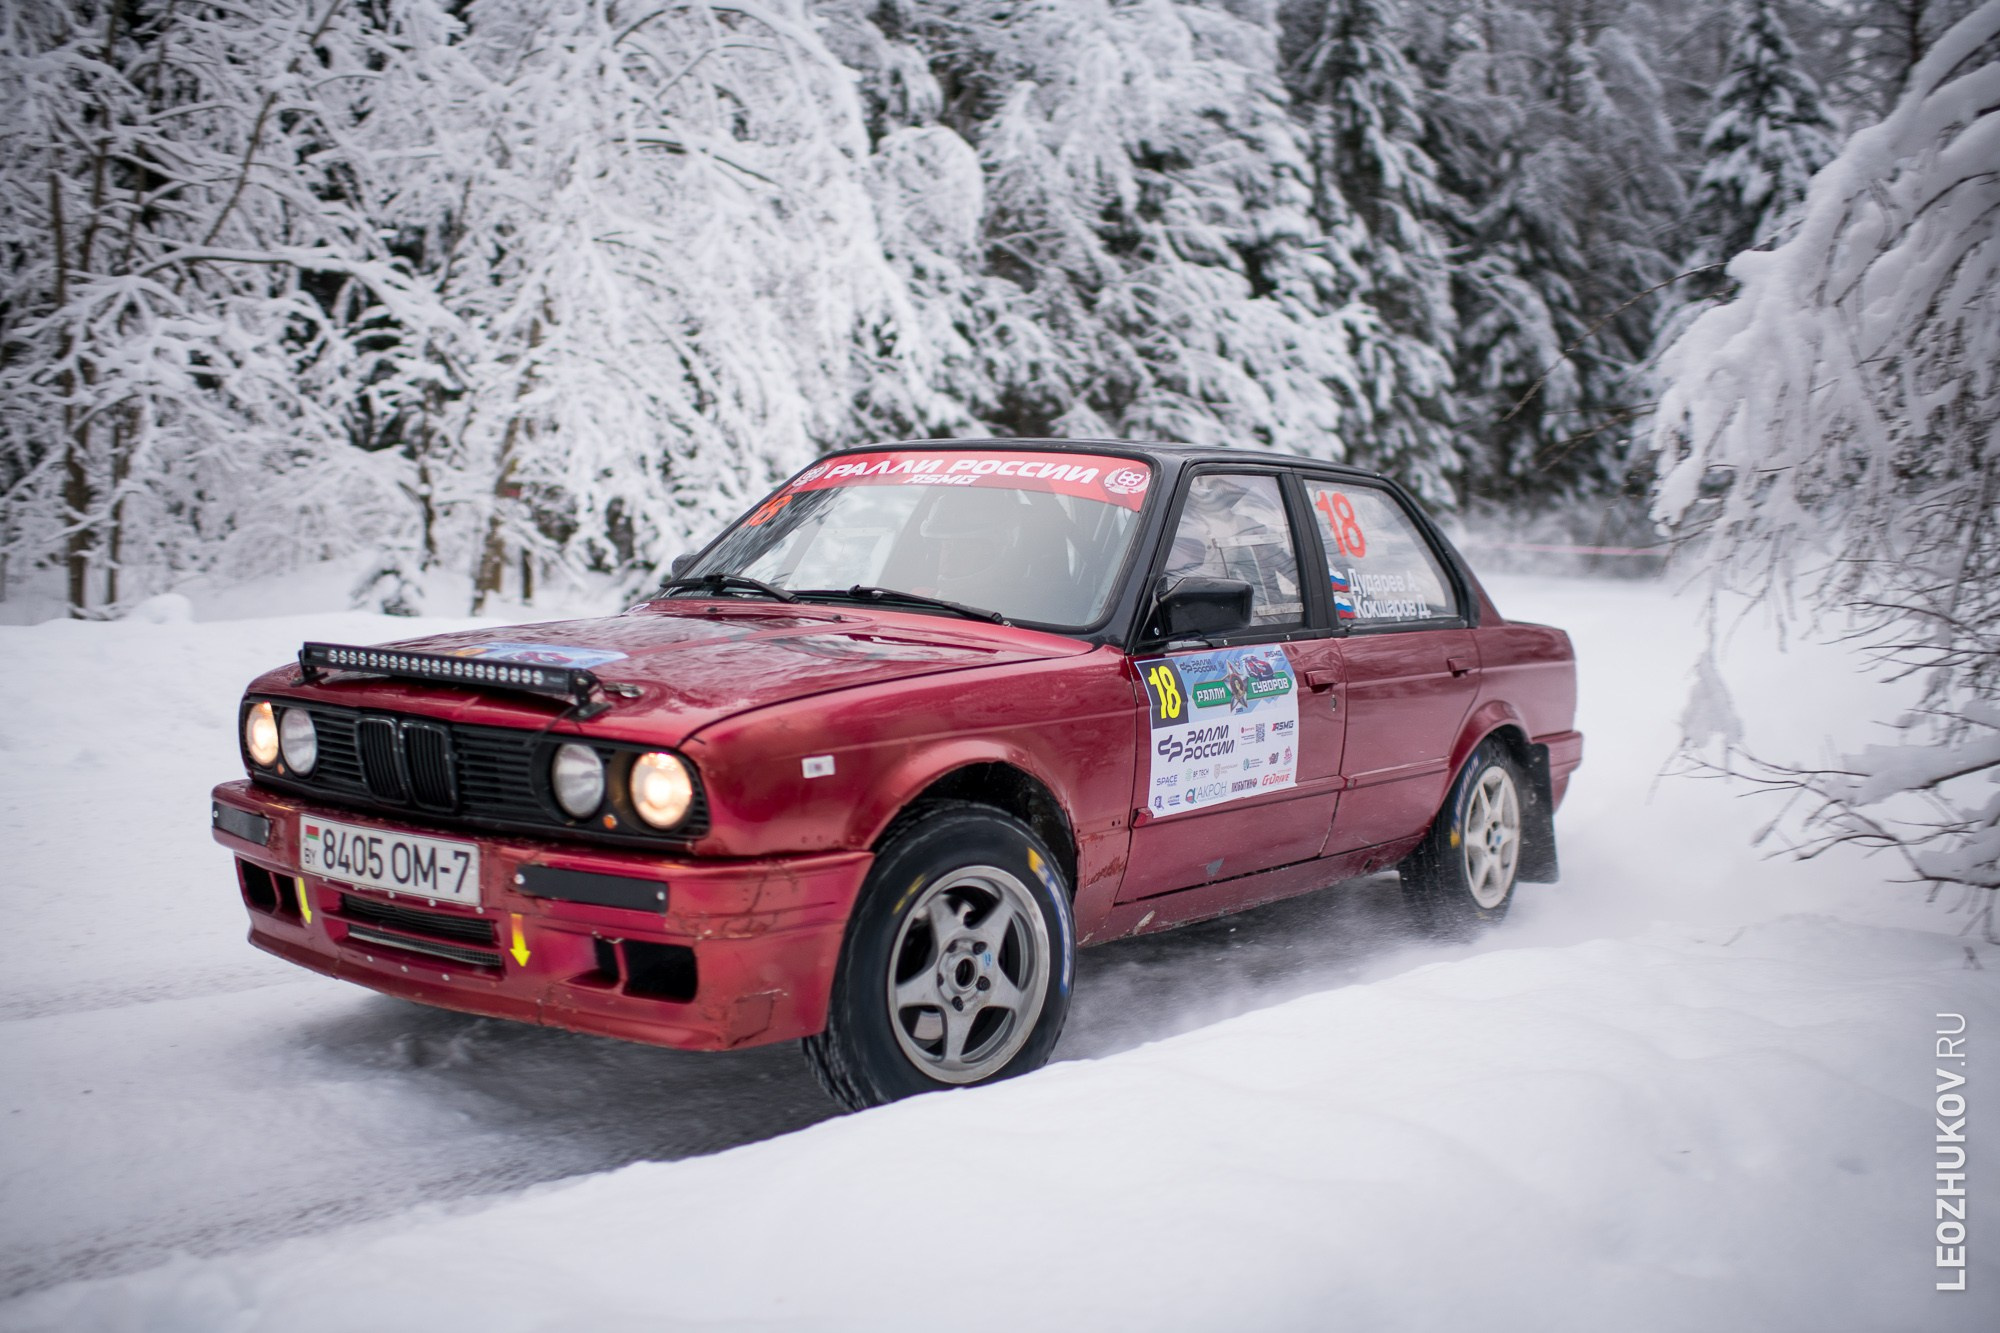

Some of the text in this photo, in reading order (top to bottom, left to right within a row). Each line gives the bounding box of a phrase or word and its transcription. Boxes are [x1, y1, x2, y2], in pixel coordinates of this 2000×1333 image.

[823, 459, 1099, 484] РАЛЛИ РОССИИ
[903, 474, 981, 485] RSMG
[1316, 491, 1366, 558] 18
[1347, 568, 1406, 598] Дударев
[1352, 595, 1417, 622] Кокшаров
[1148, 665, 1181, 720] 18
[1196, 687, 1226, 703] РАЛЛИ
[1251, 677, 1290, 694] СУВОРОВ
[1185, 724, 1229, 746] РАЛЛИ
[1271, 720, 1294, 732] RSMG
[1182, 739, 1235, 763] РОССИИ
[1156, 774, 1178, 786] SPACE
[1196, 782, 1228, 800] АКРОН
[304, 847, 317, 866] BY
[323, 828, 384, 880] 8405
